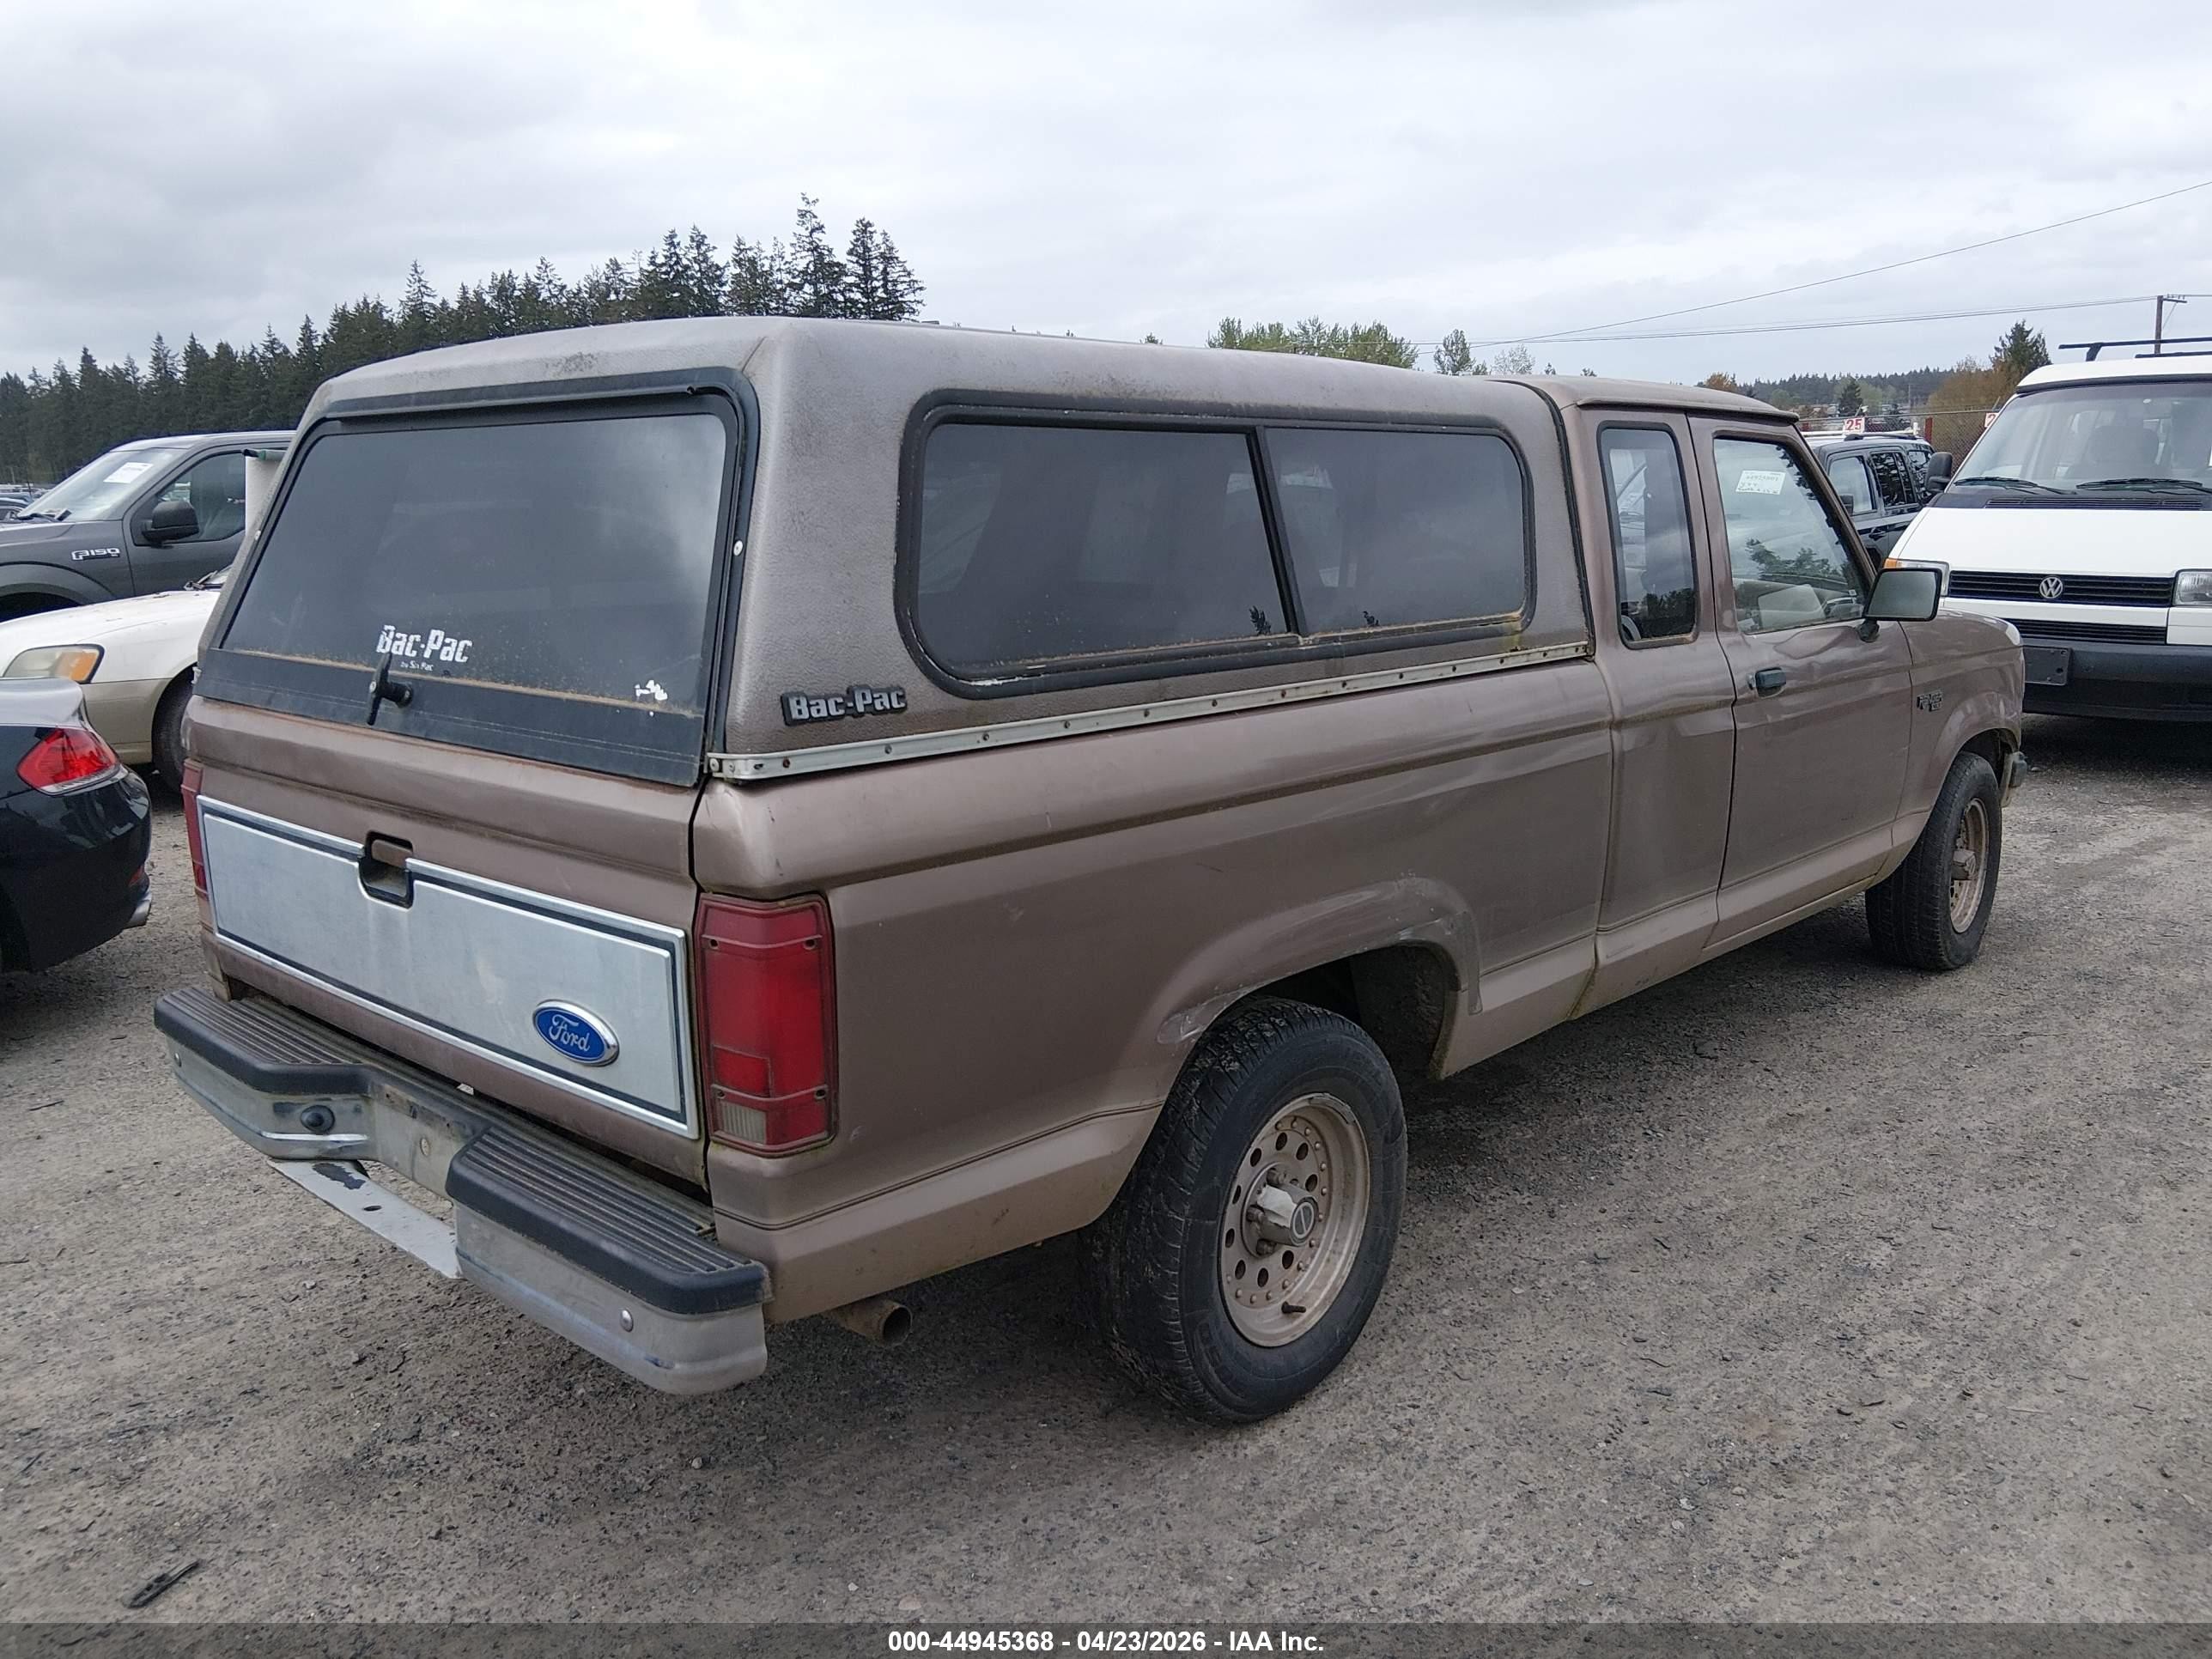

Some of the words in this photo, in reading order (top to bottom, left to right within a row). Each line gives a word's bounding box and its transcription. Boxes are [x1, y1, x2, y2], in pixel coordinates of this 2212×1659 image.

[1845, 417, 1863, 430] 25
[71, 548, 120, 561] F150
[2039, 576, 2063, 599] VW
[787, 688, 907, 720] Bac-Pac
[549, 1014, 591, 1052] Ford
